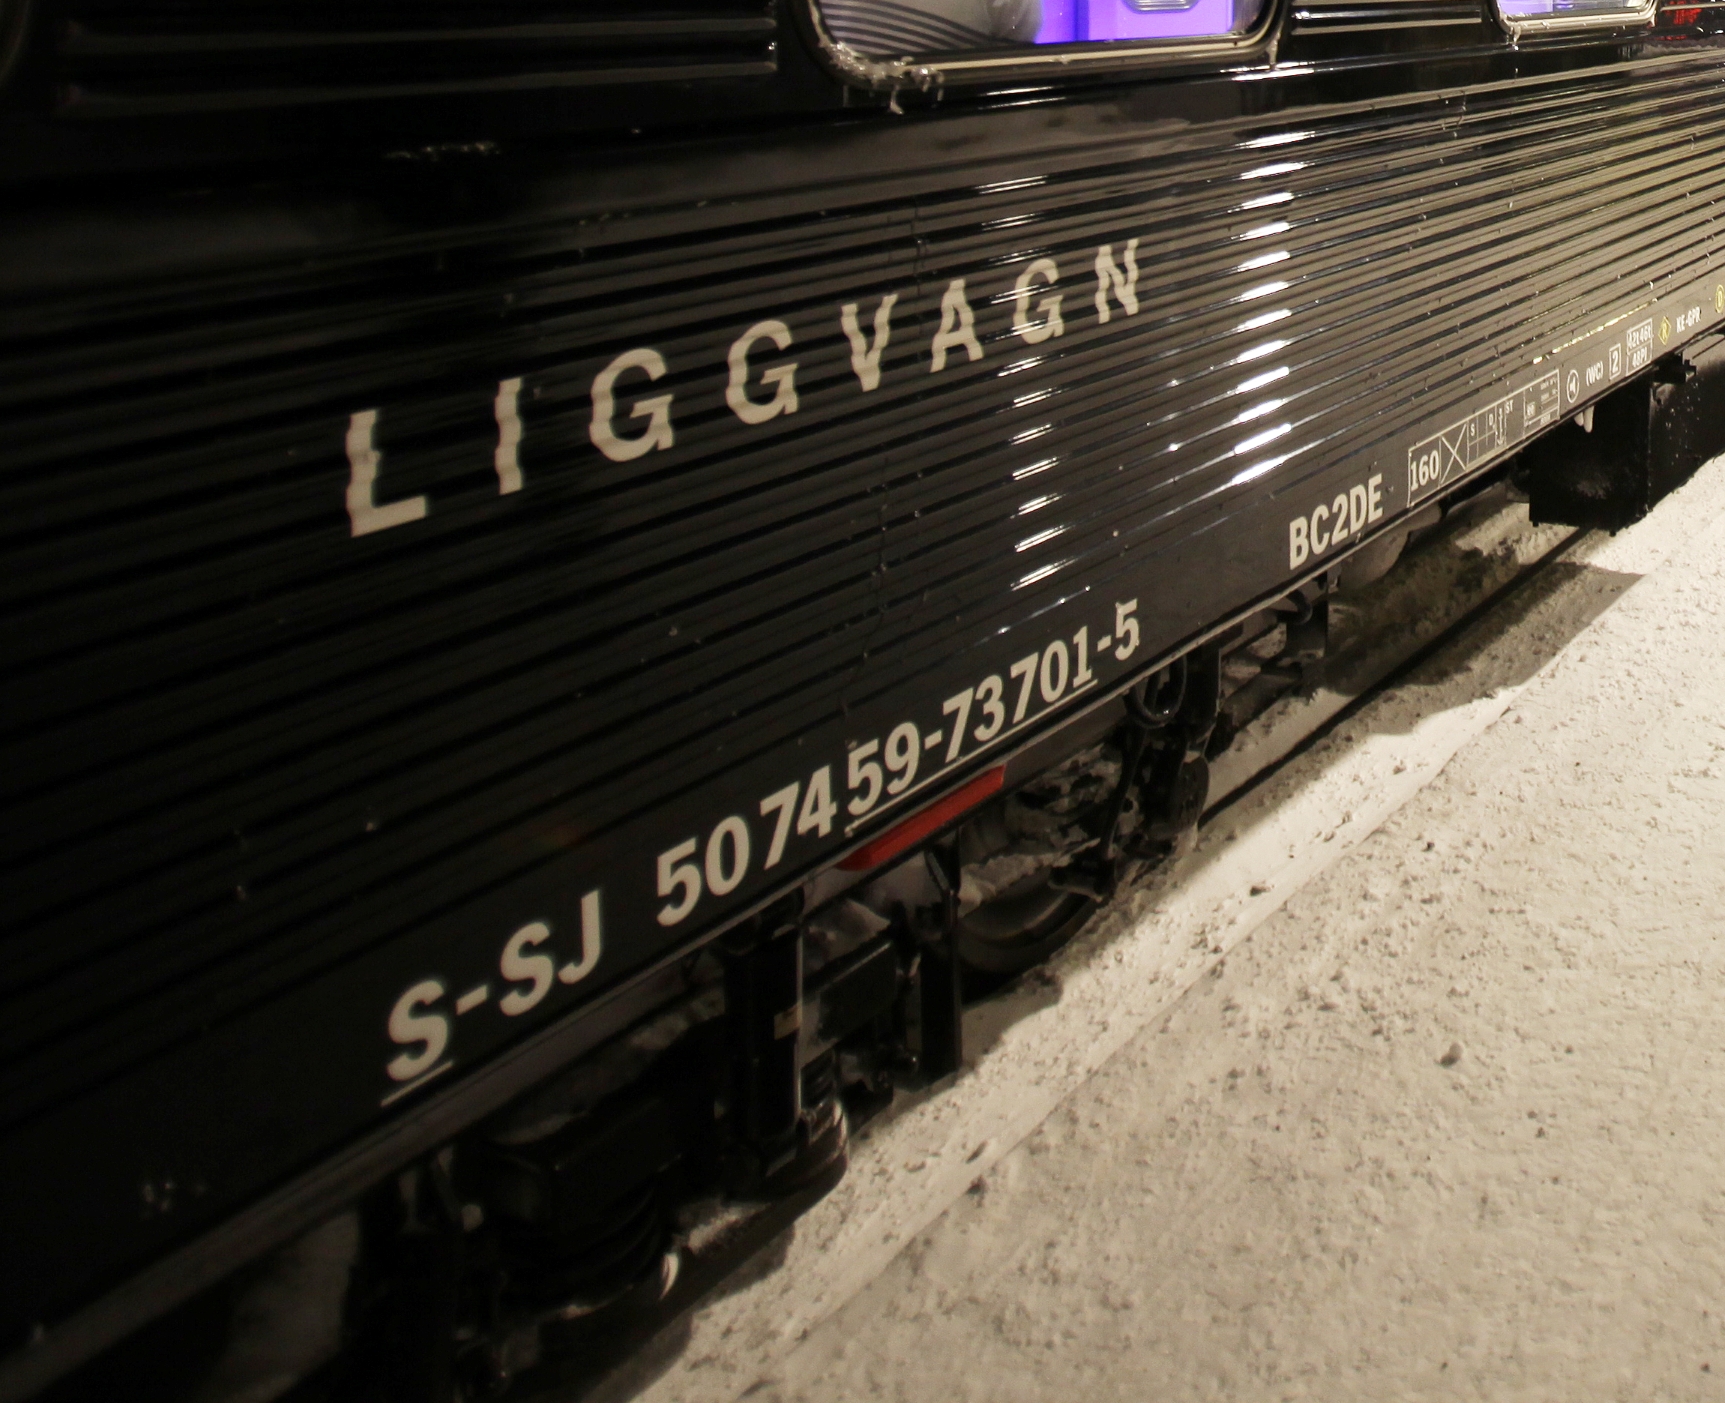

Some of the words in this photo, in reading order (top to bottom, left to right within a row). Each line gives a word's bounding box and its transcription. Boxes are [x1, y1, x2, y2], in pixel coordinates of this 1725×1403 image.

[344, 237, 1140, 538] LIGGVAGN
[1585, 360, 1604, 386] (WC)
[1611, 350, 1619, 374] 2
[1410, 449, 1440, 492] 160
[1289, 472, 1384, 571] BC2DE
[386, 889, 601, 1083] S-SJ
